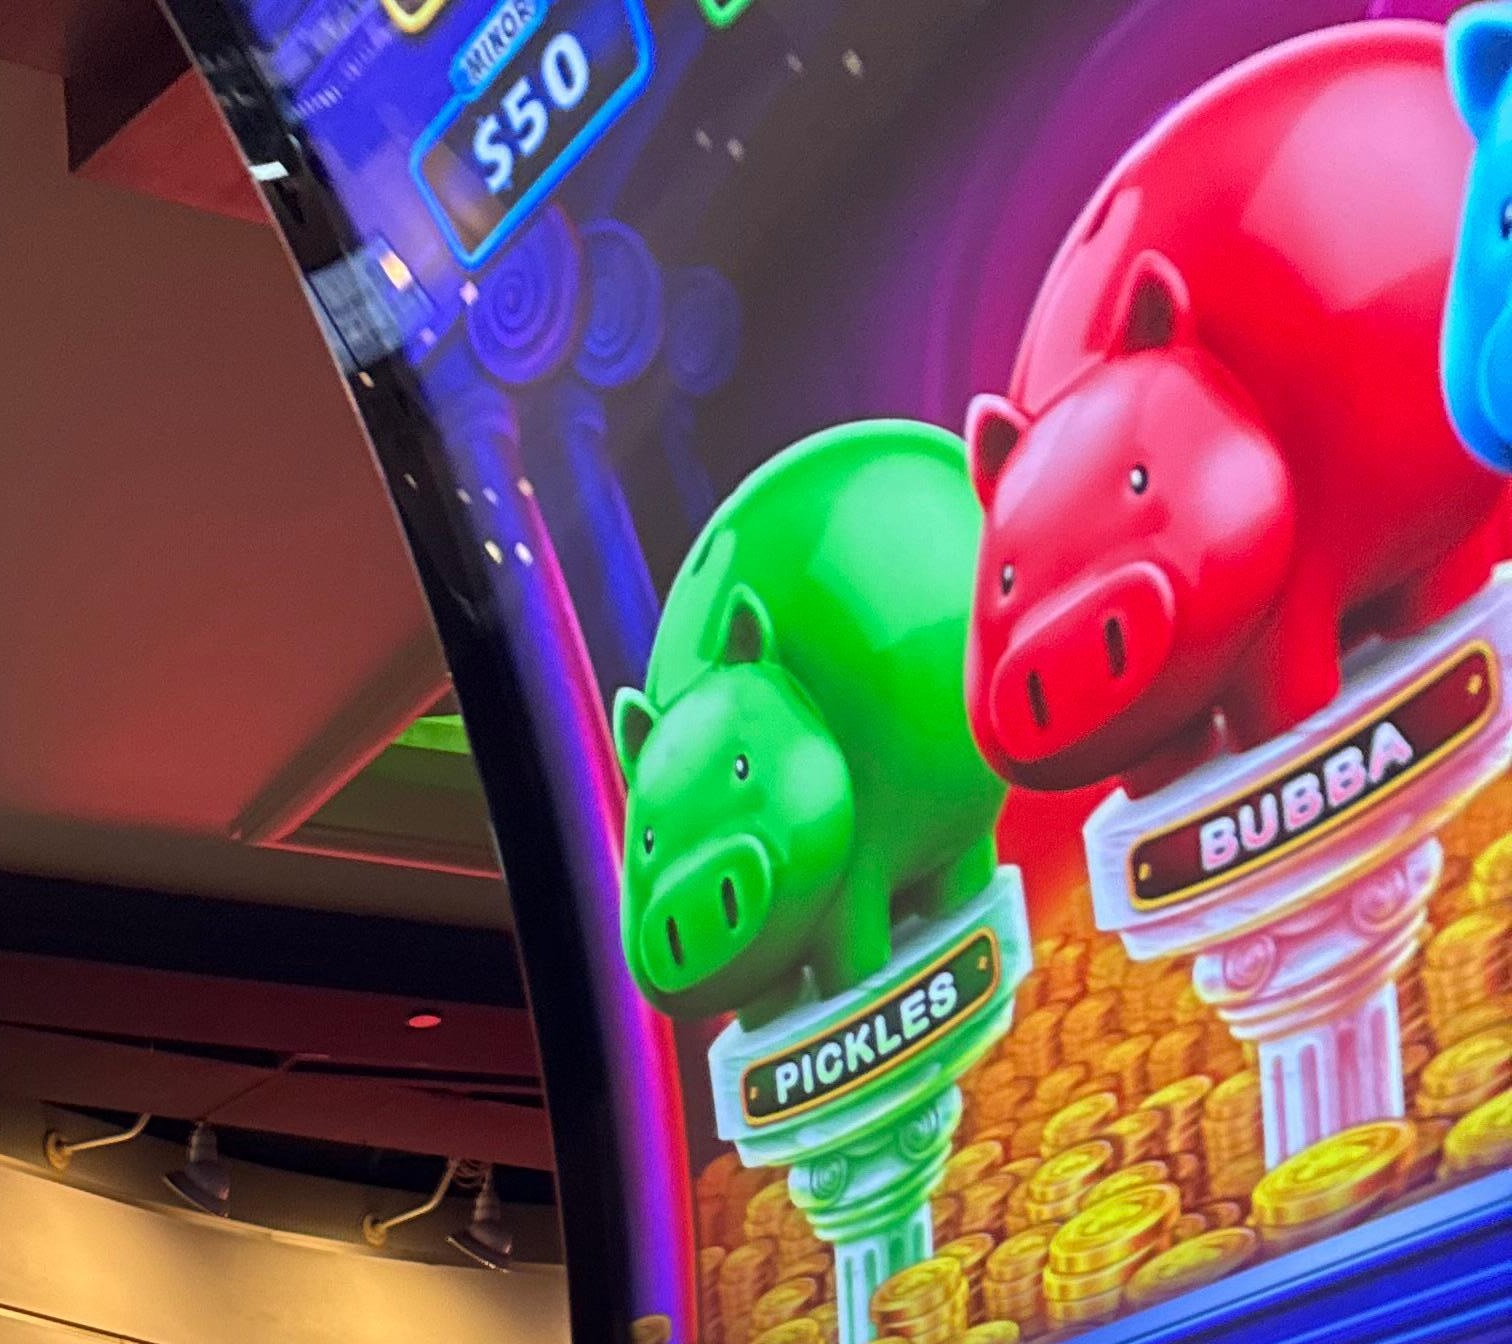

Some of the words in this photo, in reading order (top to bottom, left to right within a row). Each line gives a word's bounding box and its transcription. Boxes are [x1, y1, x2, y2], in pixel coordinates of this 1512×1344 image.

[463, 0, 536, 85] MINOR
[473, 32, 589, 194] $50
[1200, 721, 1413, 871] BUBBA
[775, 971, 957, 1104] PICKLES
